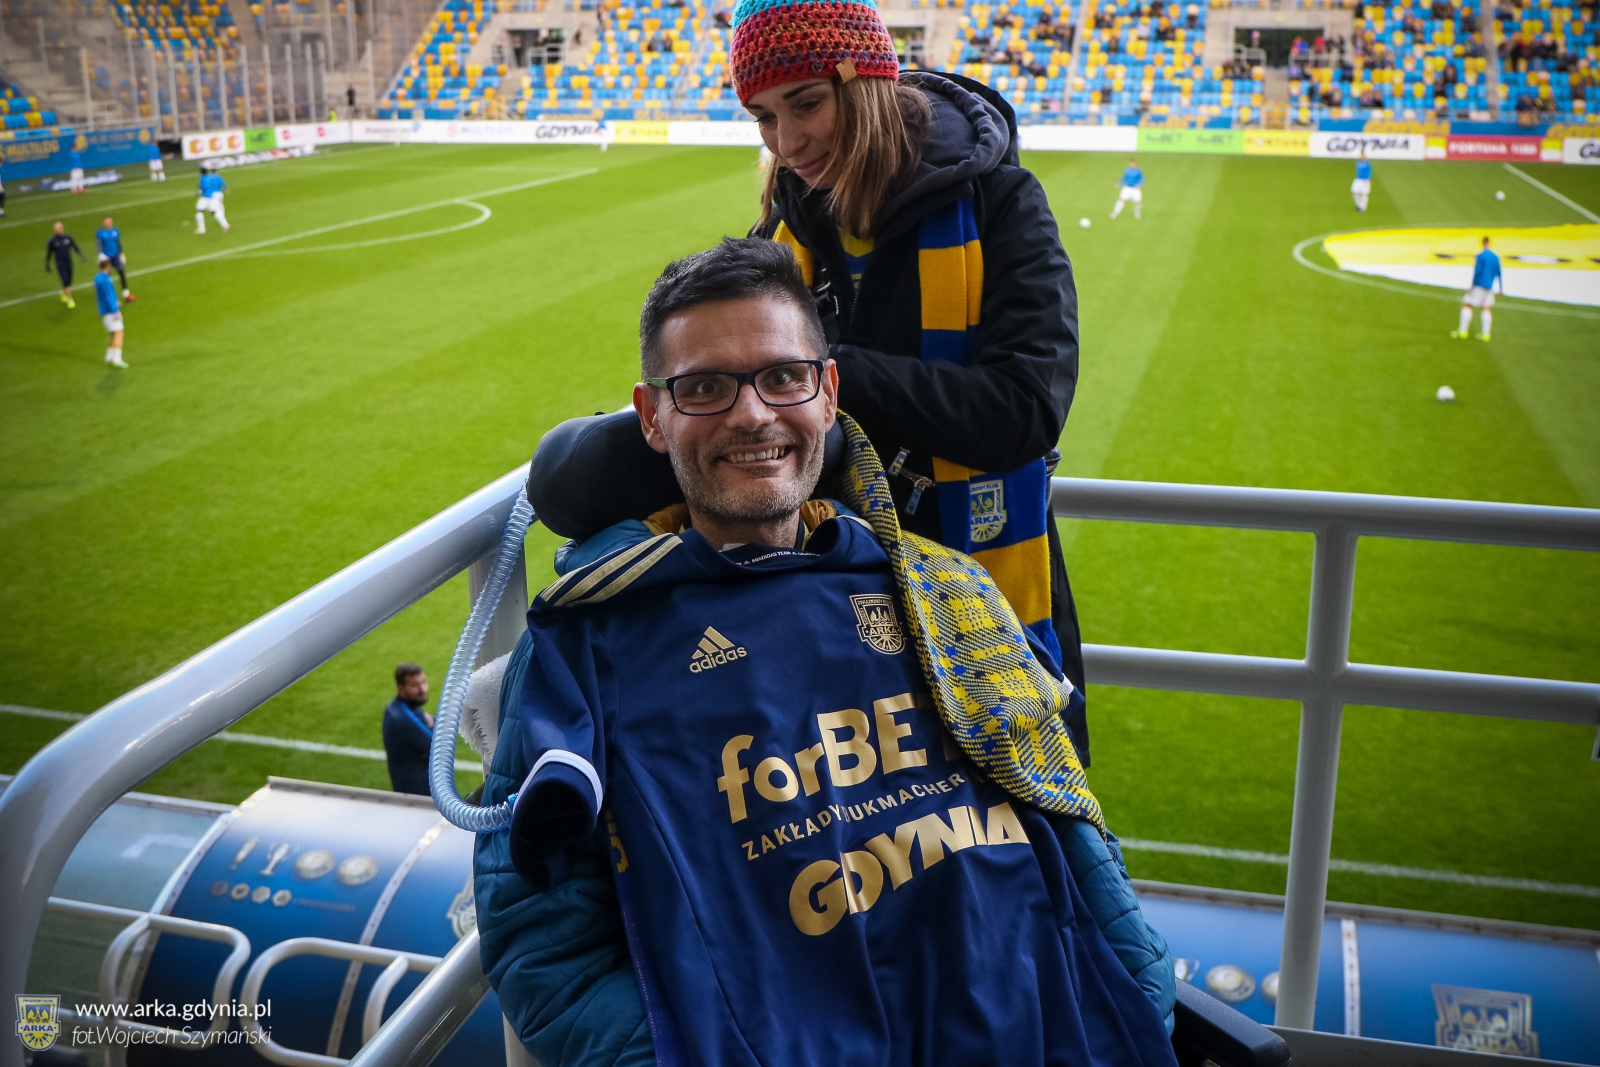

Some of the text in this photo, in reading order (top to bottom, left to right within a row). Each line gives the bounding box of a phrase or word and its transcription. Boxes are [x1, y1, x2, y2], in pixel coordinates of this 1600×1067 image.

[534, 124, 599, 139] GDYNI
[1326, 136, 1411, 152] GDYNIA
[1448, 141, 1508, 154] FORTUNA
[869, 626, 898, 636] ARKA
[689, 646, 748, 673] adidas
[741, 804, 843, 861] ZAKŁADY
[789, 801, 1031, 936] GDYNIA
